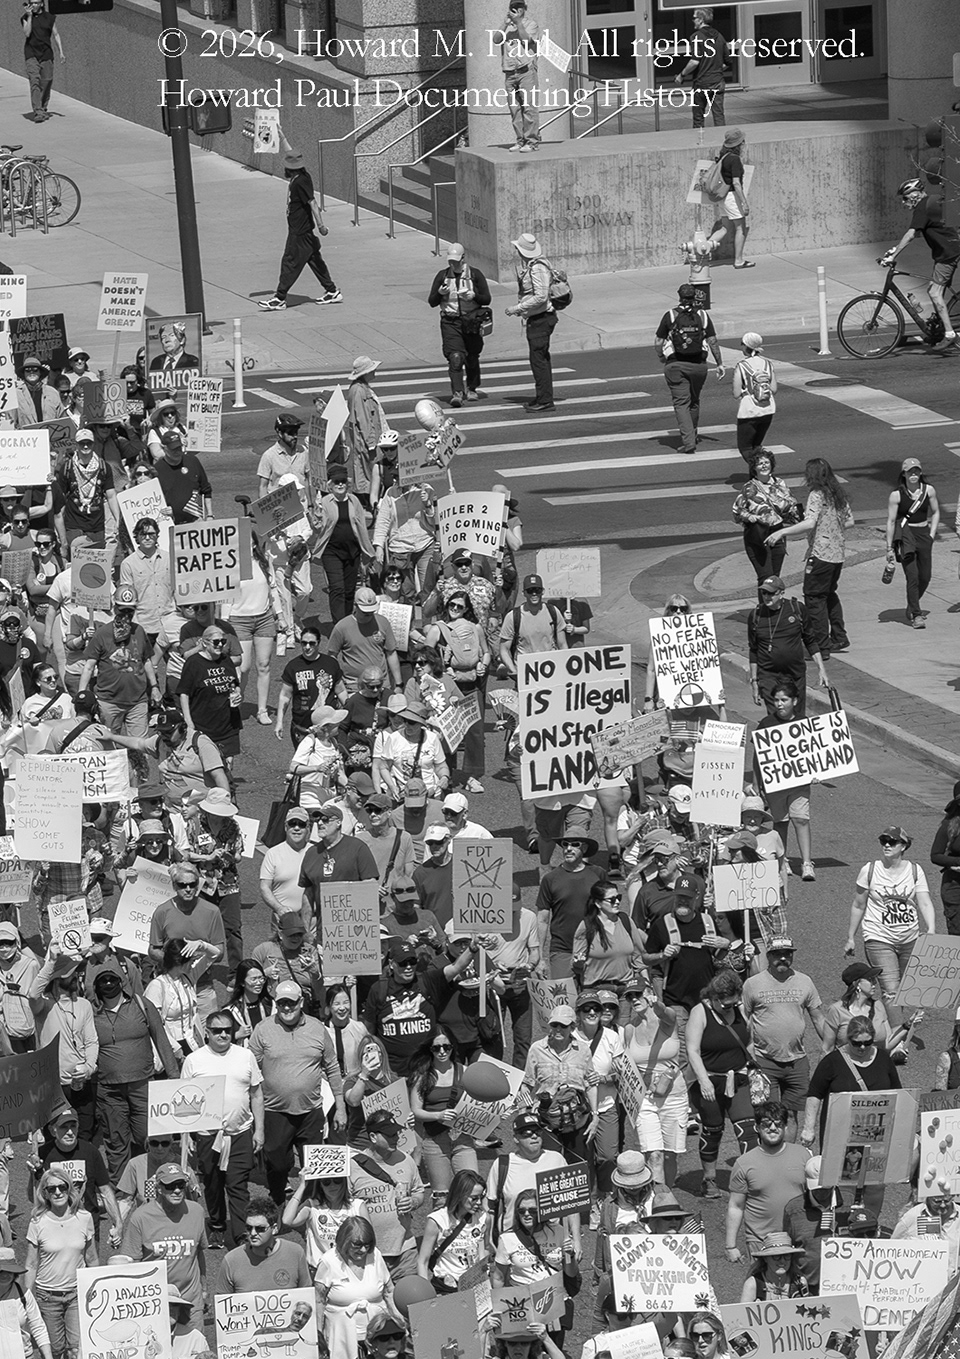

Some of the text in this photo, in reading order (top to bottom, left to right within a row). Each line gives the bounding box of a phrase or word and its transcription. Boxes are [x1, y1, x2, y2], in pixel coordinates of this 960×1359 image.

[565, 195, 601, 210] 1300
[533, 213, 634, 231] BROADWAY
[104, 286, 144, 295] DOESN'T
[101, 308, 141, 317] AMERICA
[176, 525, 237, 552] TRUMP
[177, 551, 237, 573] RAPES
[202, 576, 235, 593] ALL
[662, 614, 706, 630] NO ICE
[652, 627, 713, 646] NO FEAR
[655, 641, 717, 662] IMMIGRANTS
[524, 647, 626, 684] NO ONE
[657, 655, 720, 675] ARE WELCOME
[673, 670, 705, 684] HERE!
[526, 680, 630, 716] IS illegal
[530, 750, 598, 791] LAND
[465, 845, 493, 857] FDT
[467, 892, 493, 909] NO
[459, 908, 505, 926] KINGS
